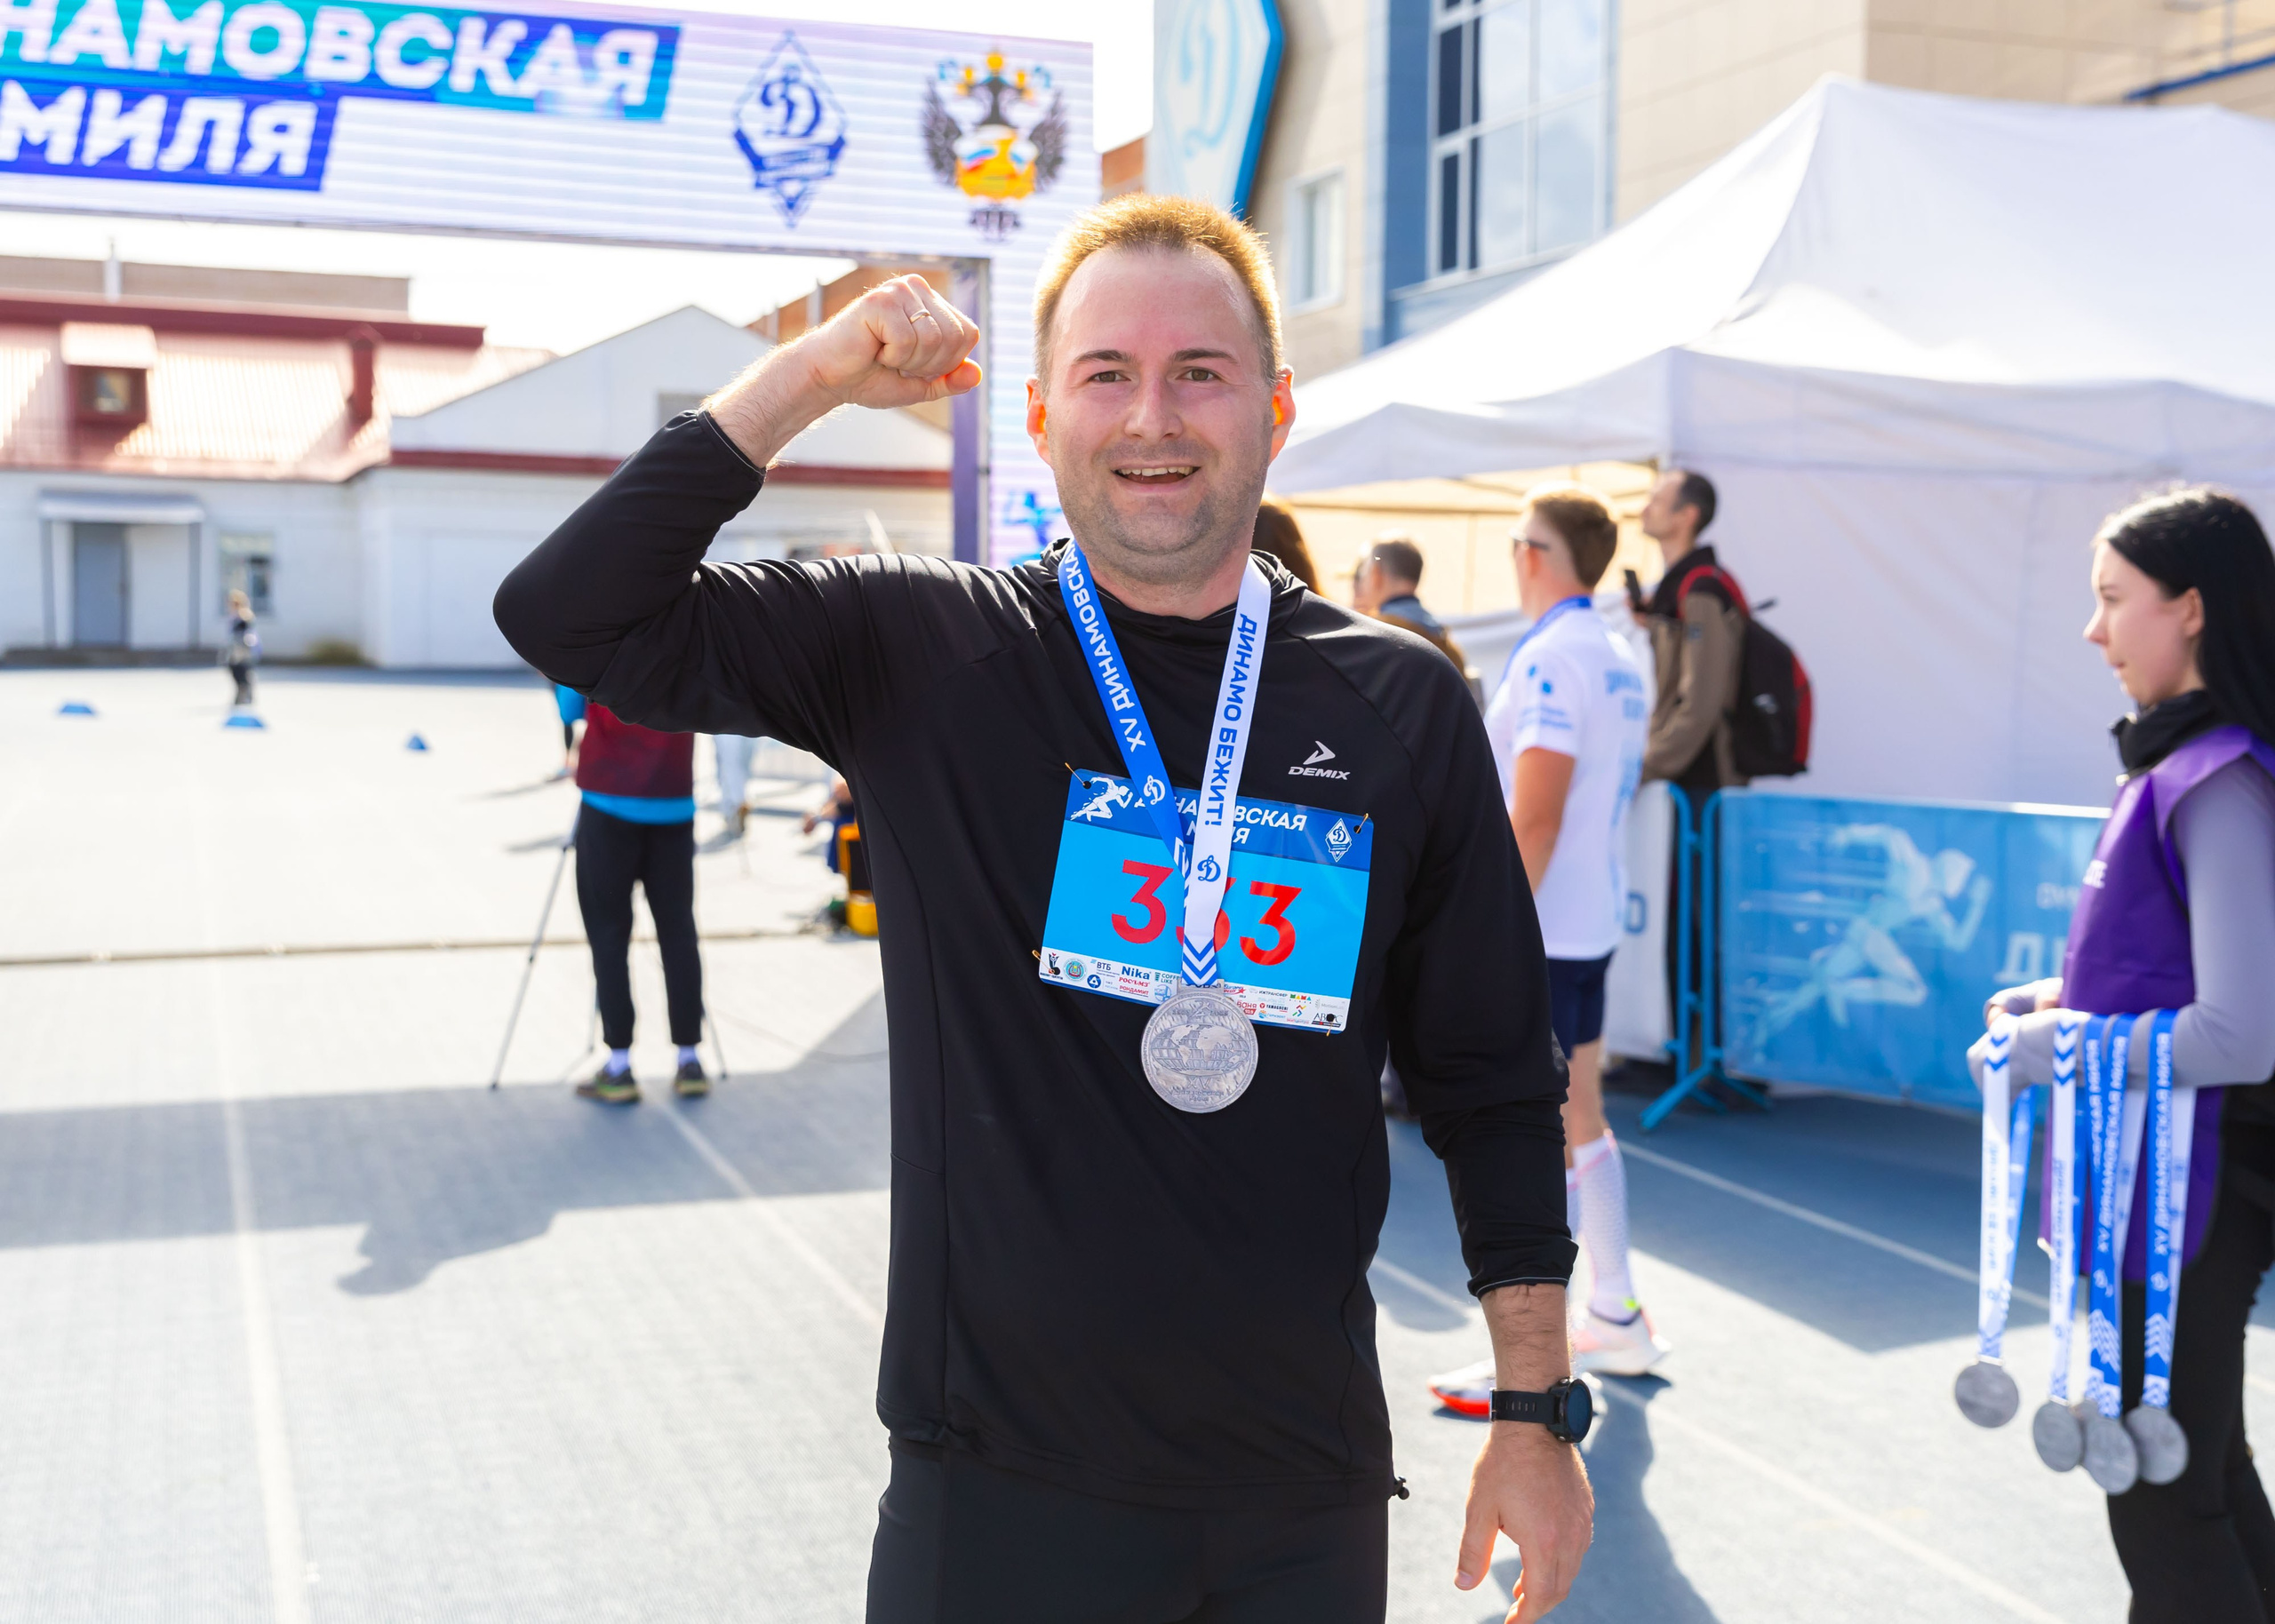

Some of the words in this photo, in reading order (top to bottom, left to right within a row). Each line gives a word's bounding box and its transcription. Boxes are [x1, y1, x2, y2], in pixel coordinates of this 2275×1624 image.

[0, 80, 319, 176] МИЛЯ
[1065, 543, 1136, 712] ДИНАМОВСКА
[1223, 613, 1257, 721] ДИНАМО
[1119, 718, 1146, 752] XV
[1204, 728, 1238, 826] БЕЖИТ!
[1288, 766, 1351, 781] DEMIX
[1096, 961, 1112, 971] ВТБ
[1122, 966, 1151, 981] Nika
